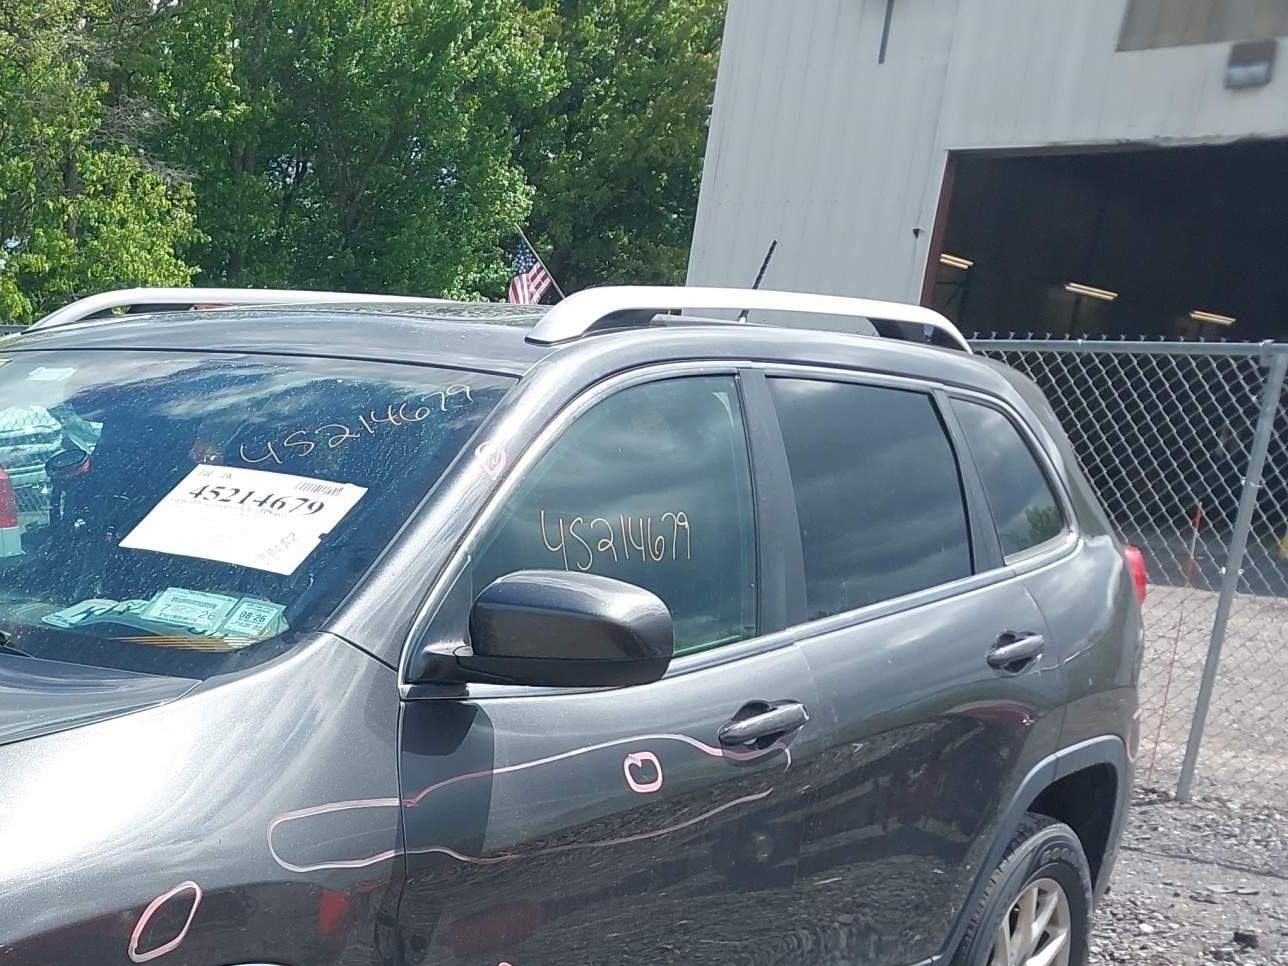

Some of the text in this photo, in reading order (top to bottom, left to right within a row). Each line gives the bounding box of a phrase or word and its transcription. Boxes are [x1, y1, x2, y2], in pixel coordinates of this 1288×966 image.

[240, 384, 474, 465] 45214679
[188, 484, 325, 516] 45214679
[540, 509, 692, 572] 45214679
